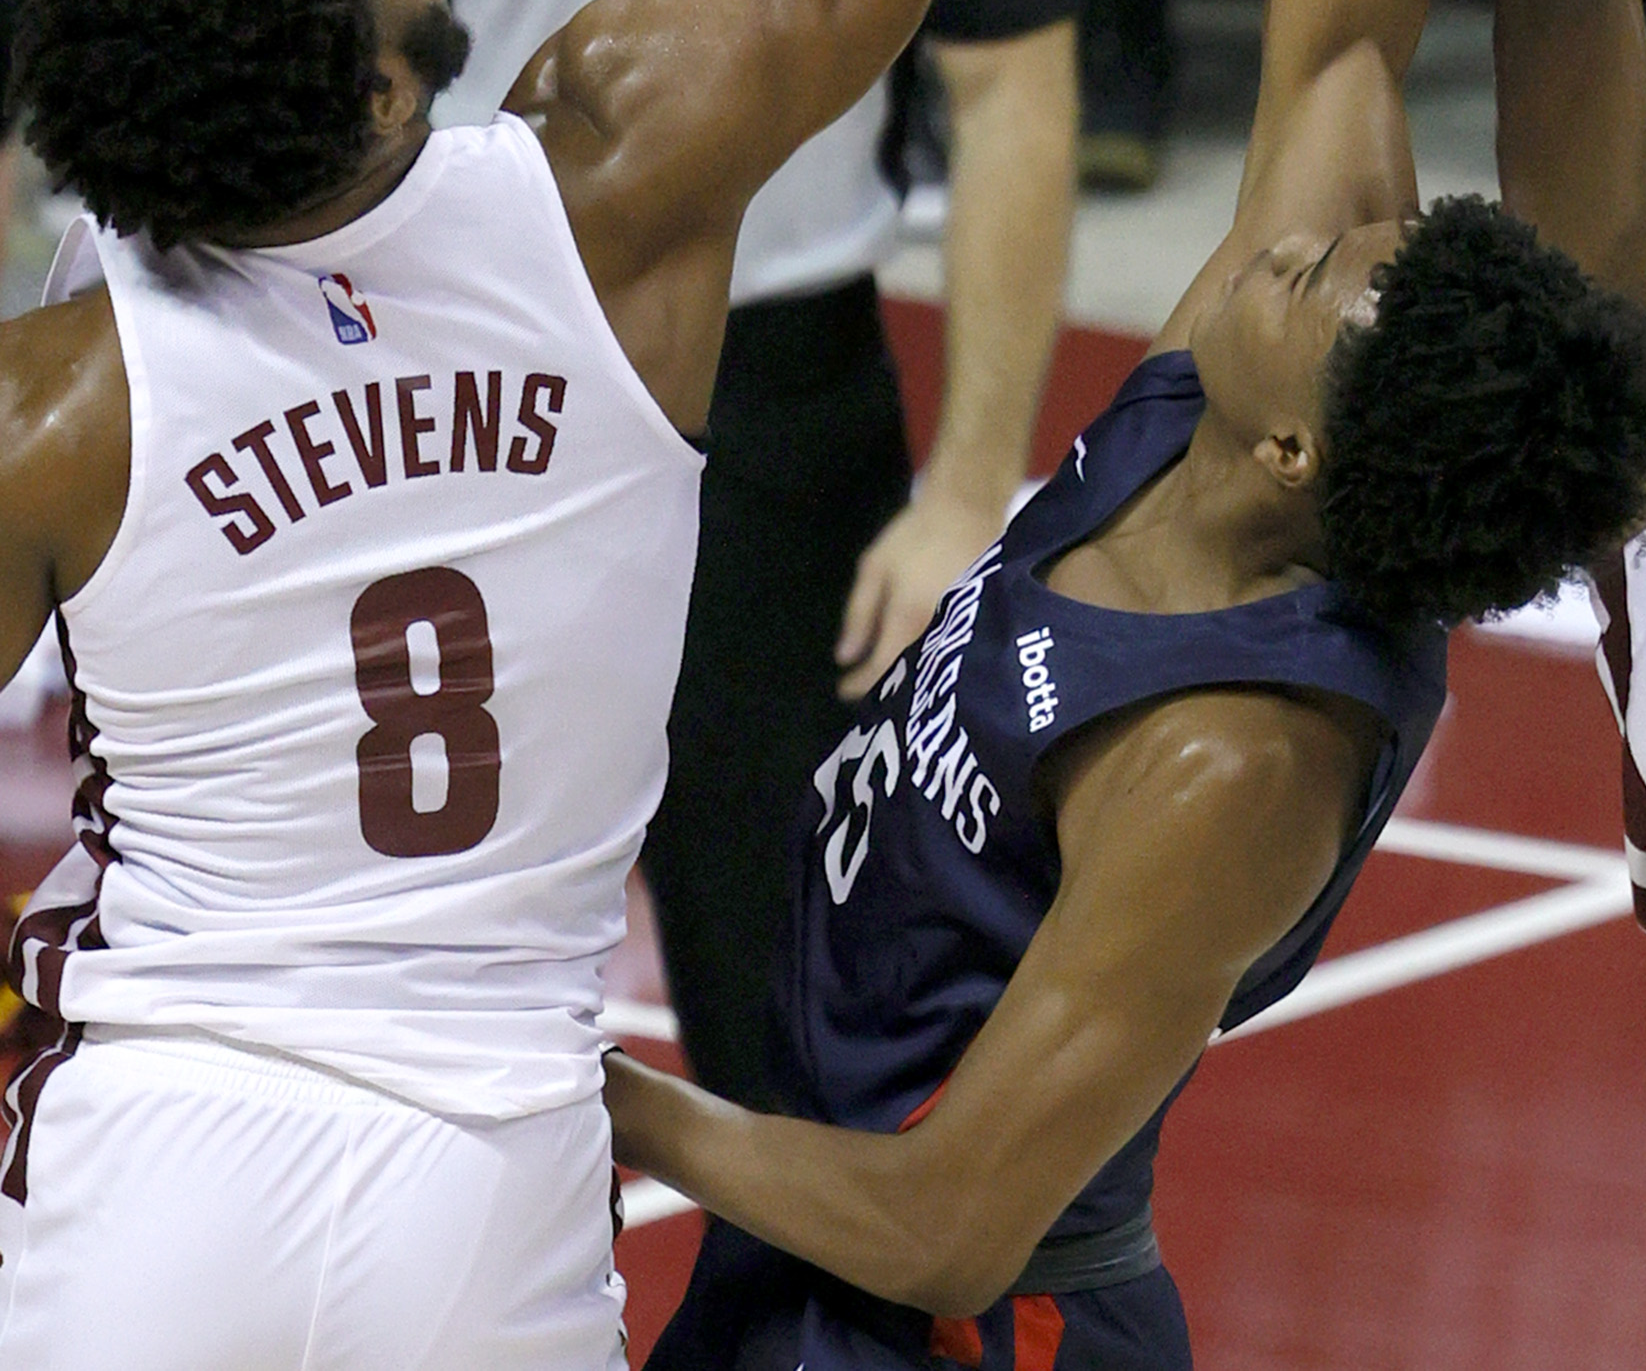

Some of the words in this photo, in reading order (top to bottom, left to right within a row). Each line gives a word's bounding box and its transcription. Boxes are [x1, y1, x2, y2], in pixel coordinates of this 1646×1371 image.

[185, 371, 567, 555] STEVENS
[350, 566, 501, 858] 8
[1017, 627, 1058, 732] ibotta
